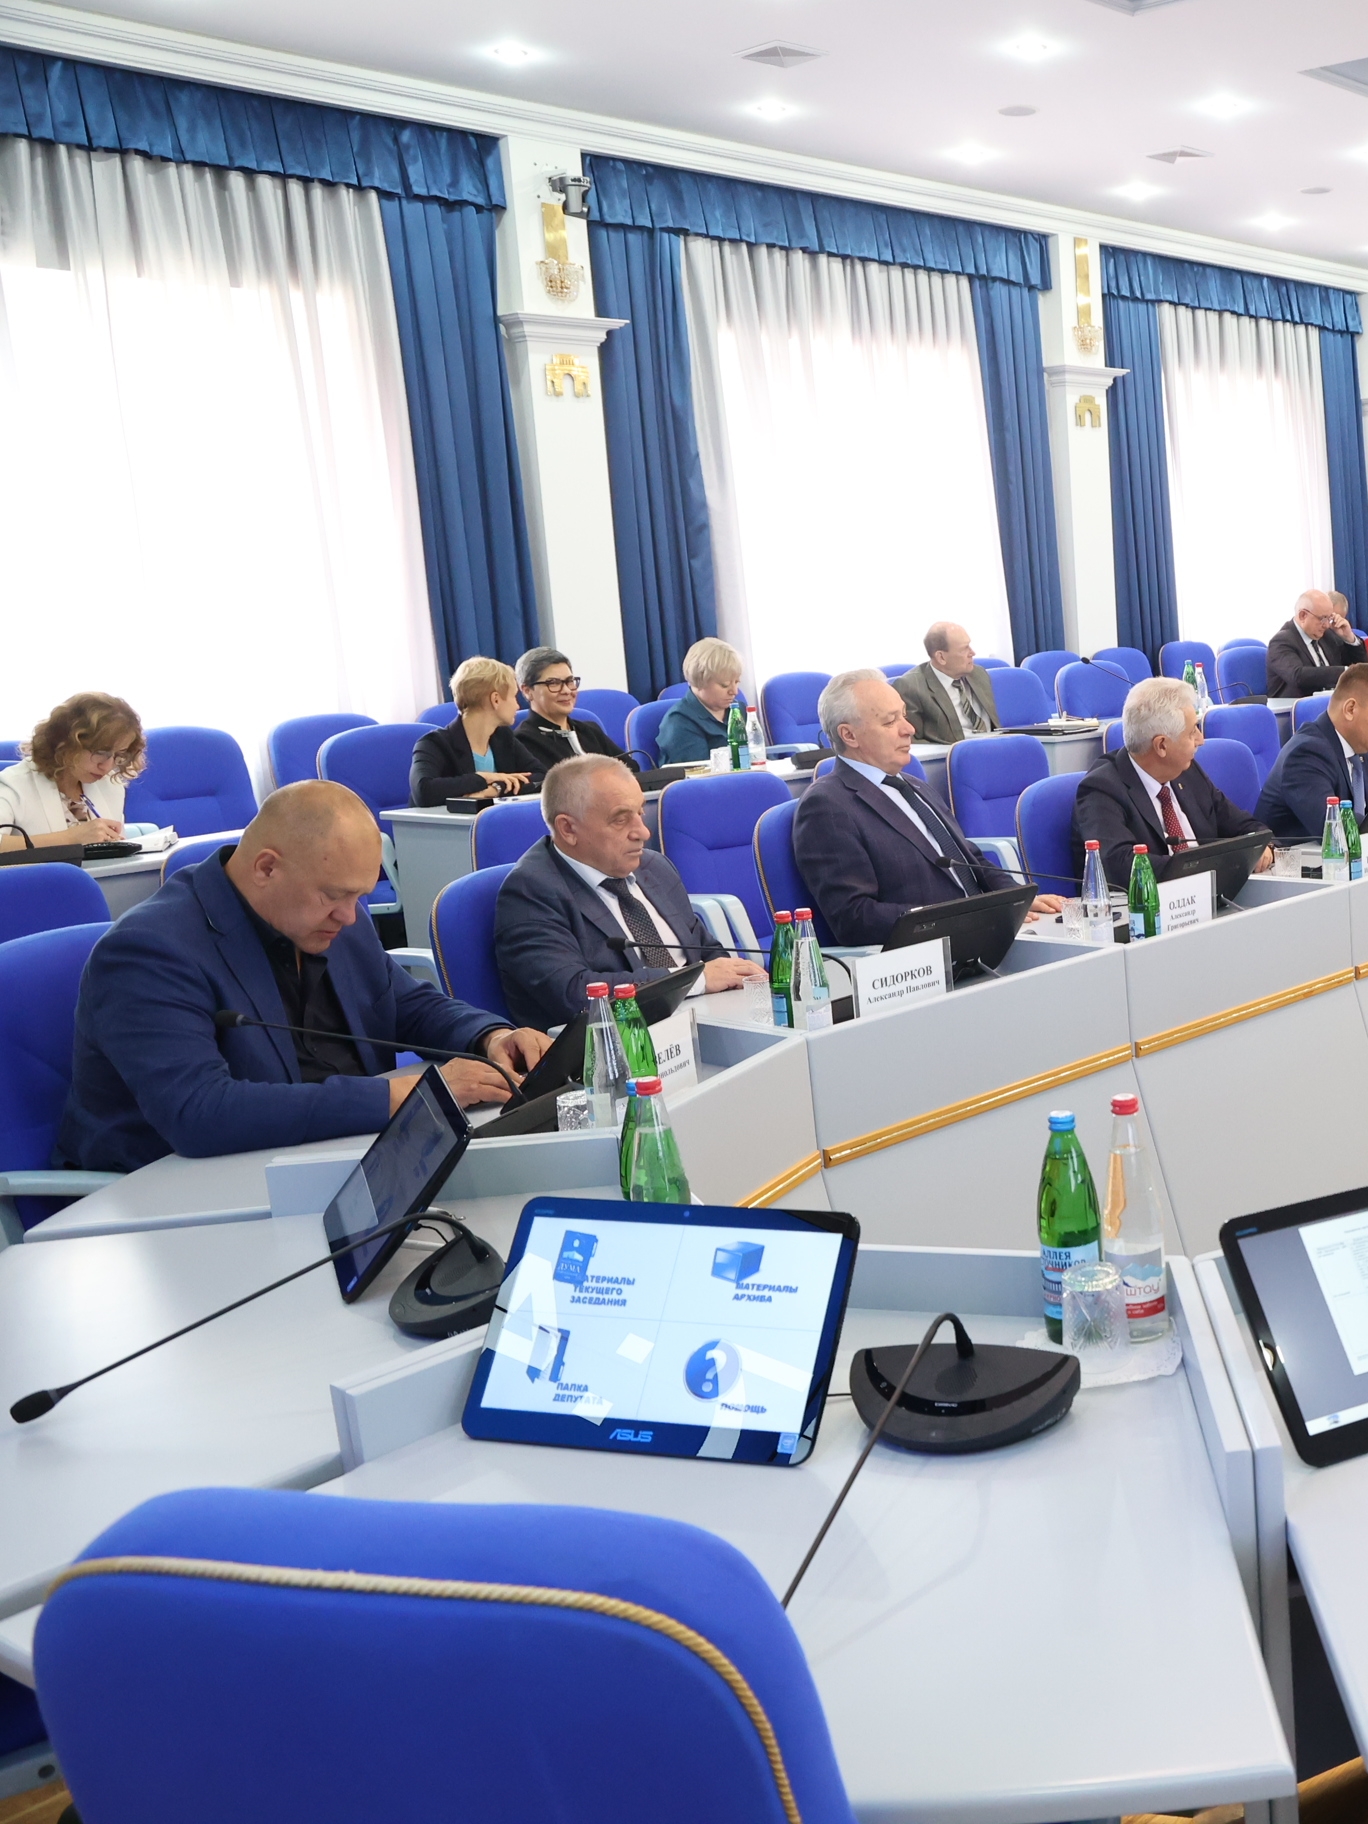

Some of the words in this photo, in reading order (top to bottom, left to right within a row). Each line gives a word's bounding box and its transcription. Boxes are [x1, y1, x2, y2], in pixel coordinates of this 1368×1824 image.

[1168, 895, 1197, 911] ОЛДАК
[1170, 909, 1197, 921] Александр
[1167, 918, 1200, 932] Григорьевич
[871, 965, 933, 991] СИДОРКОВ
[866, 988, 905, 1005] Александр
[905, 979, 940, 994] Павлович
[658, 1058, 690, 1079] нольдович
[584, 1275, 635, 1286] АТЕРИАЛЫ
[573, 1284, 623, 1296] ТЕКУЩЕГО
[735, 1282, 798, 1294] МАТЕРИАЛЫ
[570, 1296, 627, 1307] ЗАСЕДАНИЯ
[732, 1293, 773, 1303] АРХИВА
[556, 1382, 588, 1392] ПАПКА
[552, 1393, 604, 1406] ДЕПУТАТА
[609, 1428, 653, 1442] ASUS
